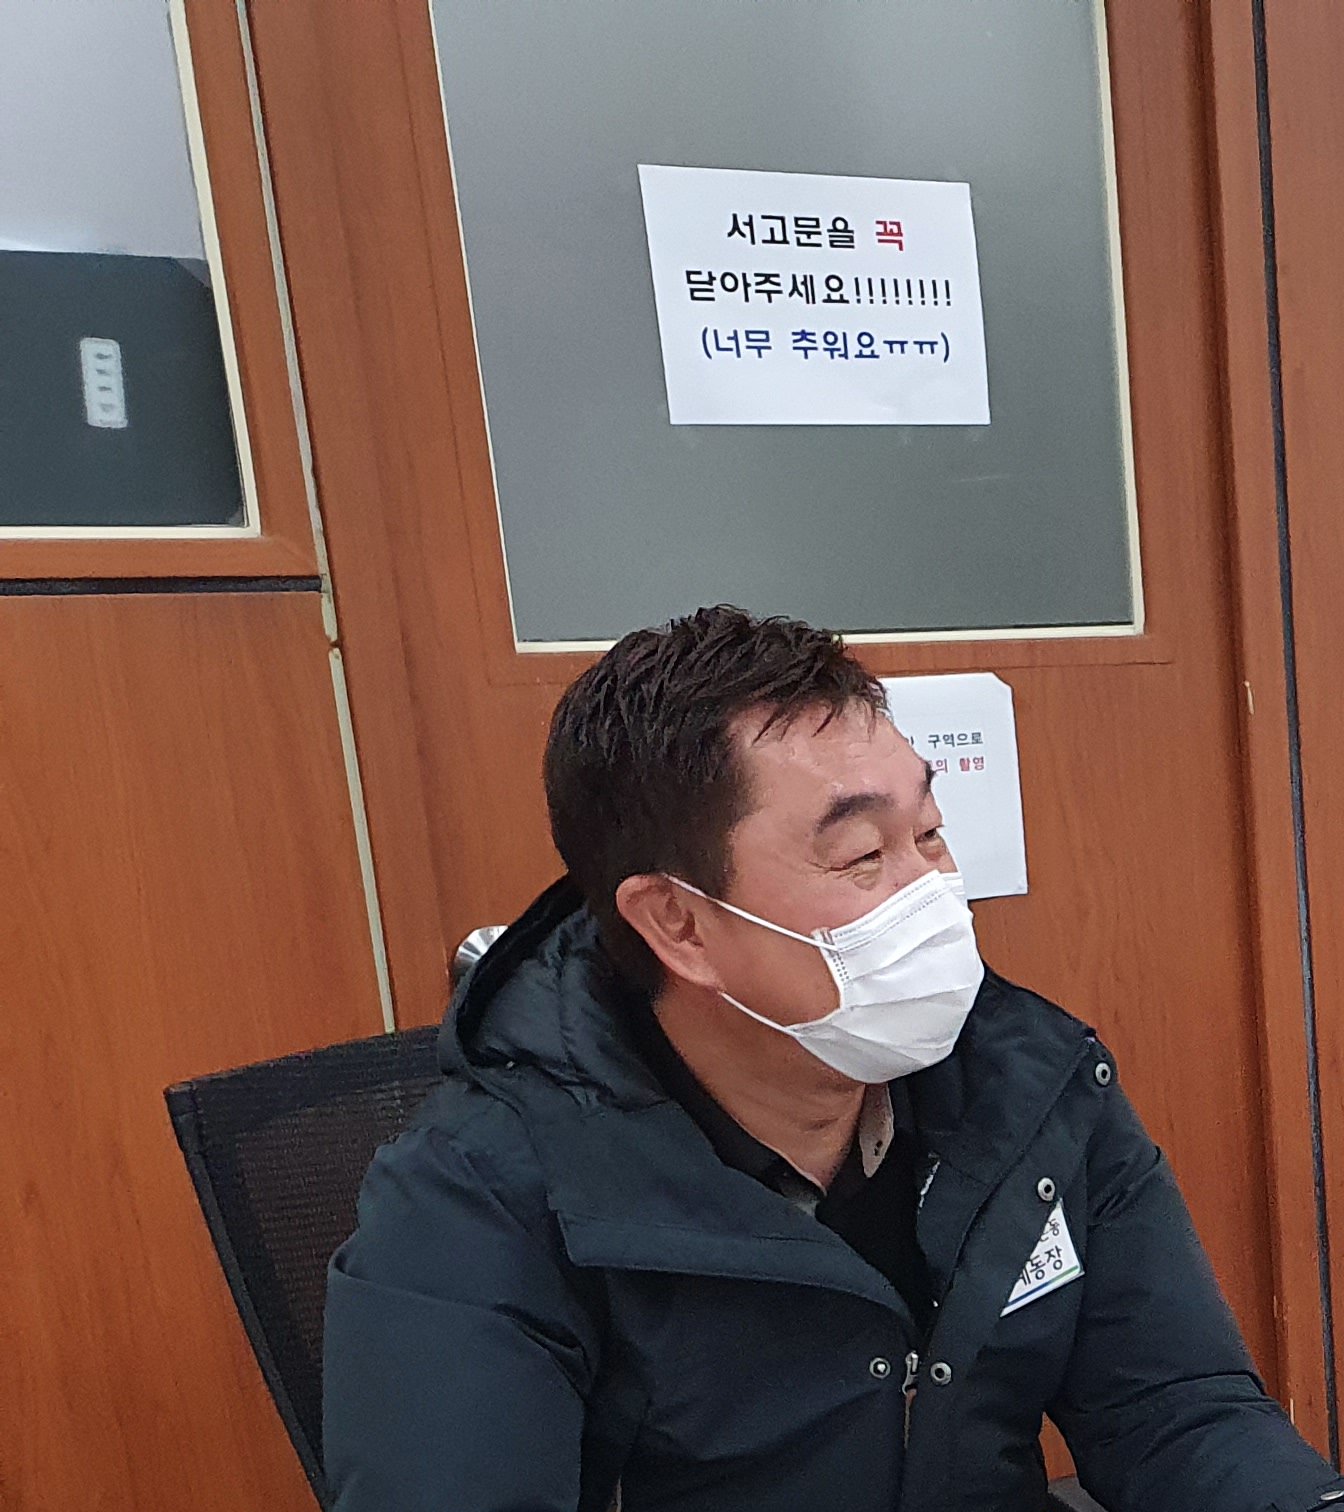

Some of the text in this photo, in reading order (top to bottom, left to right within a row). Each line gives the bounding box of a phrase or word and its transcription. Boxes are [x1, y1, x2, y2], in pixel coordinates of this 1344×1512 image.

[727, 212, 905, 252] 서고문을 꼭
[685, 269, 953, 307] 닫아주세요!!!!!!!!
[701, 326, 951, 363] (너무 추워요ㅠㅠ)
[927, 732, 984, 749] 구역으로
